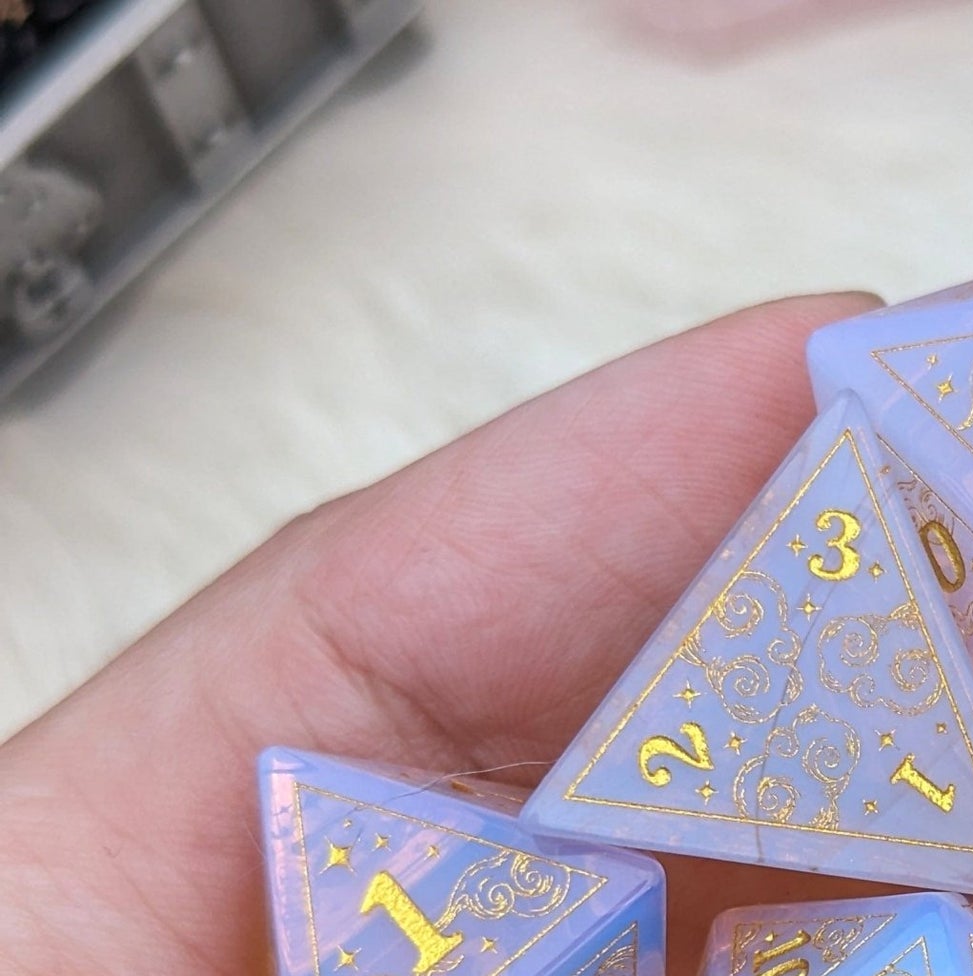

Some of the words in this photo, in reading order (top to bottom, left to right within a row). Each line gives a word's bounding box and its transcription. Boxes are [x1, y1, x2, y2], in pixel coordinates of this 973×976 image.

[808, 509, 861, 582] 3
[919, 520, 967, 594] 0
[638, 722, 715, 786] 2
[890, 753, 956, 812] 1
[360, 870, 464, 974] 1
